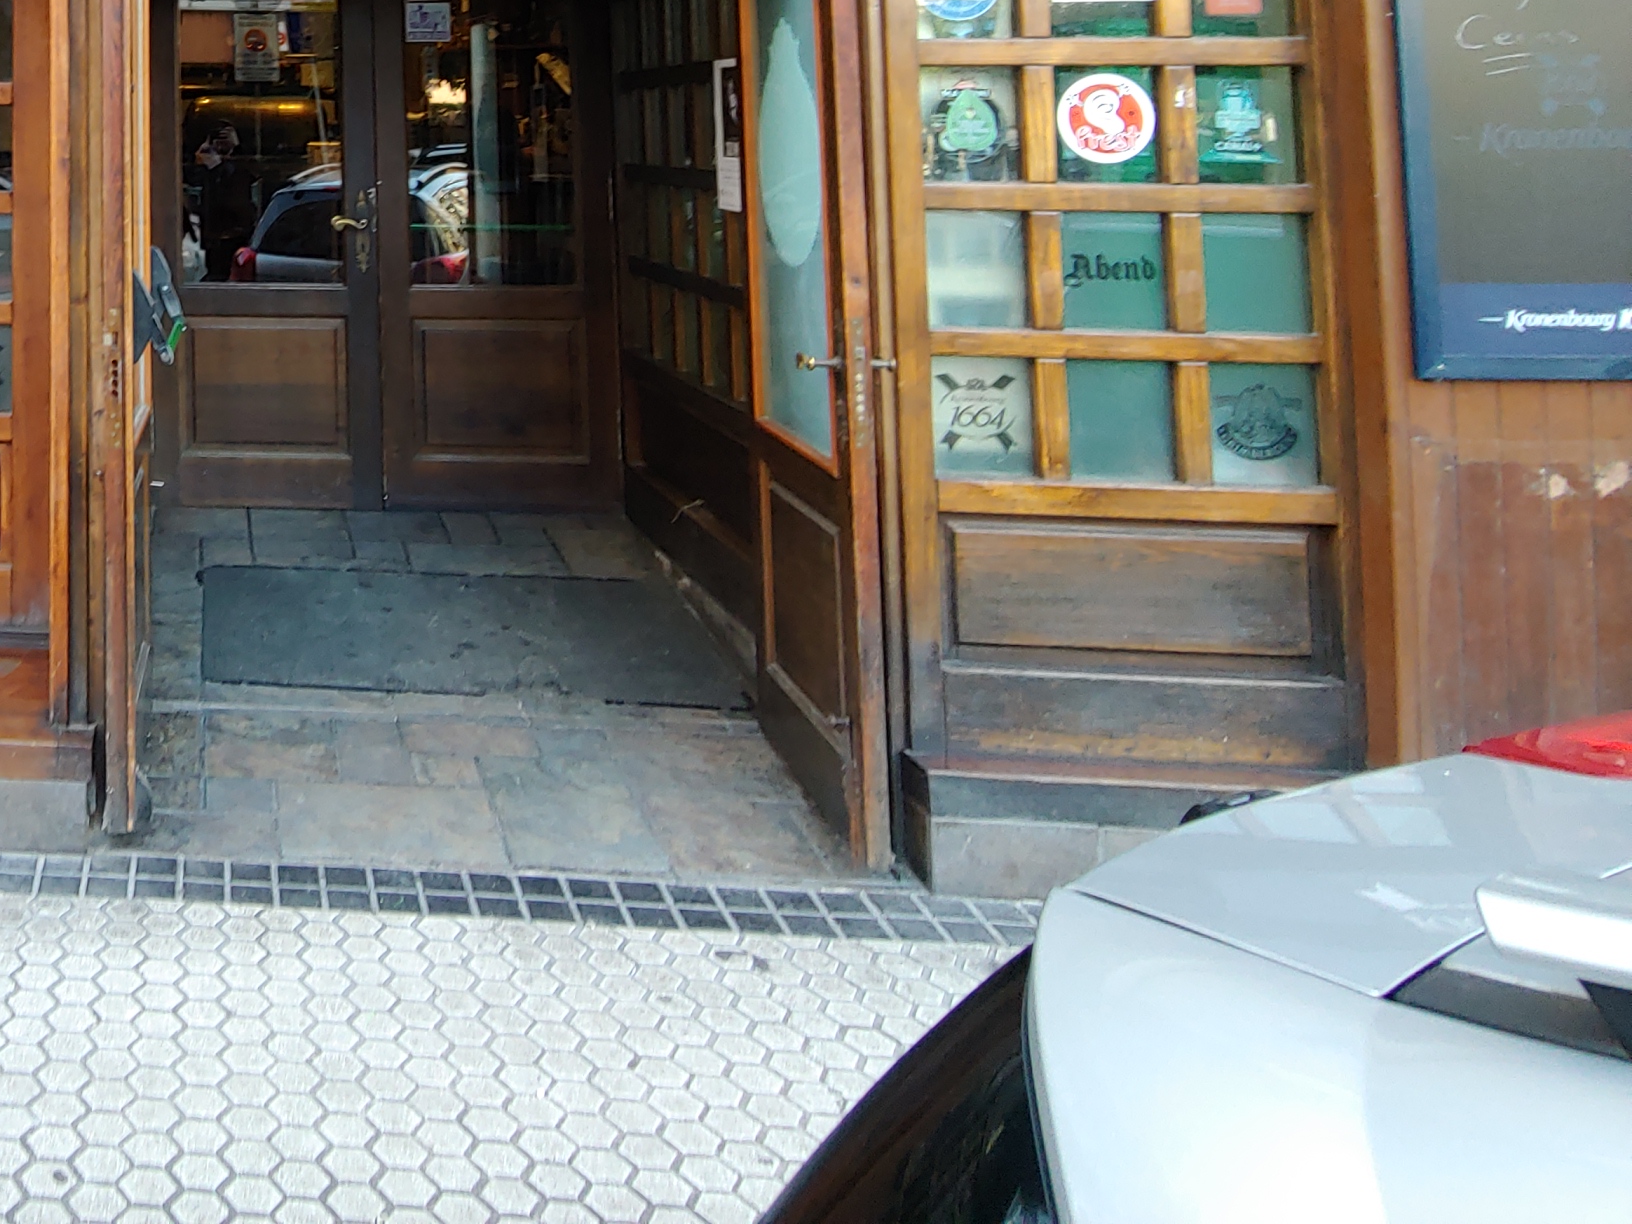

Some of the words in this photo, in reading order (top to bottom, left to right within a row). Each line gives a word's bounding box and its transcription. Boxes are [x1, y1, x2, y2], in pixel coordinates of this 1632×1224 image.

[1064, 252, 1157, 289] Abend
[1504, 307, 1618, 333] Kronenbourg
[951, 403, 1006, 430] 1664
